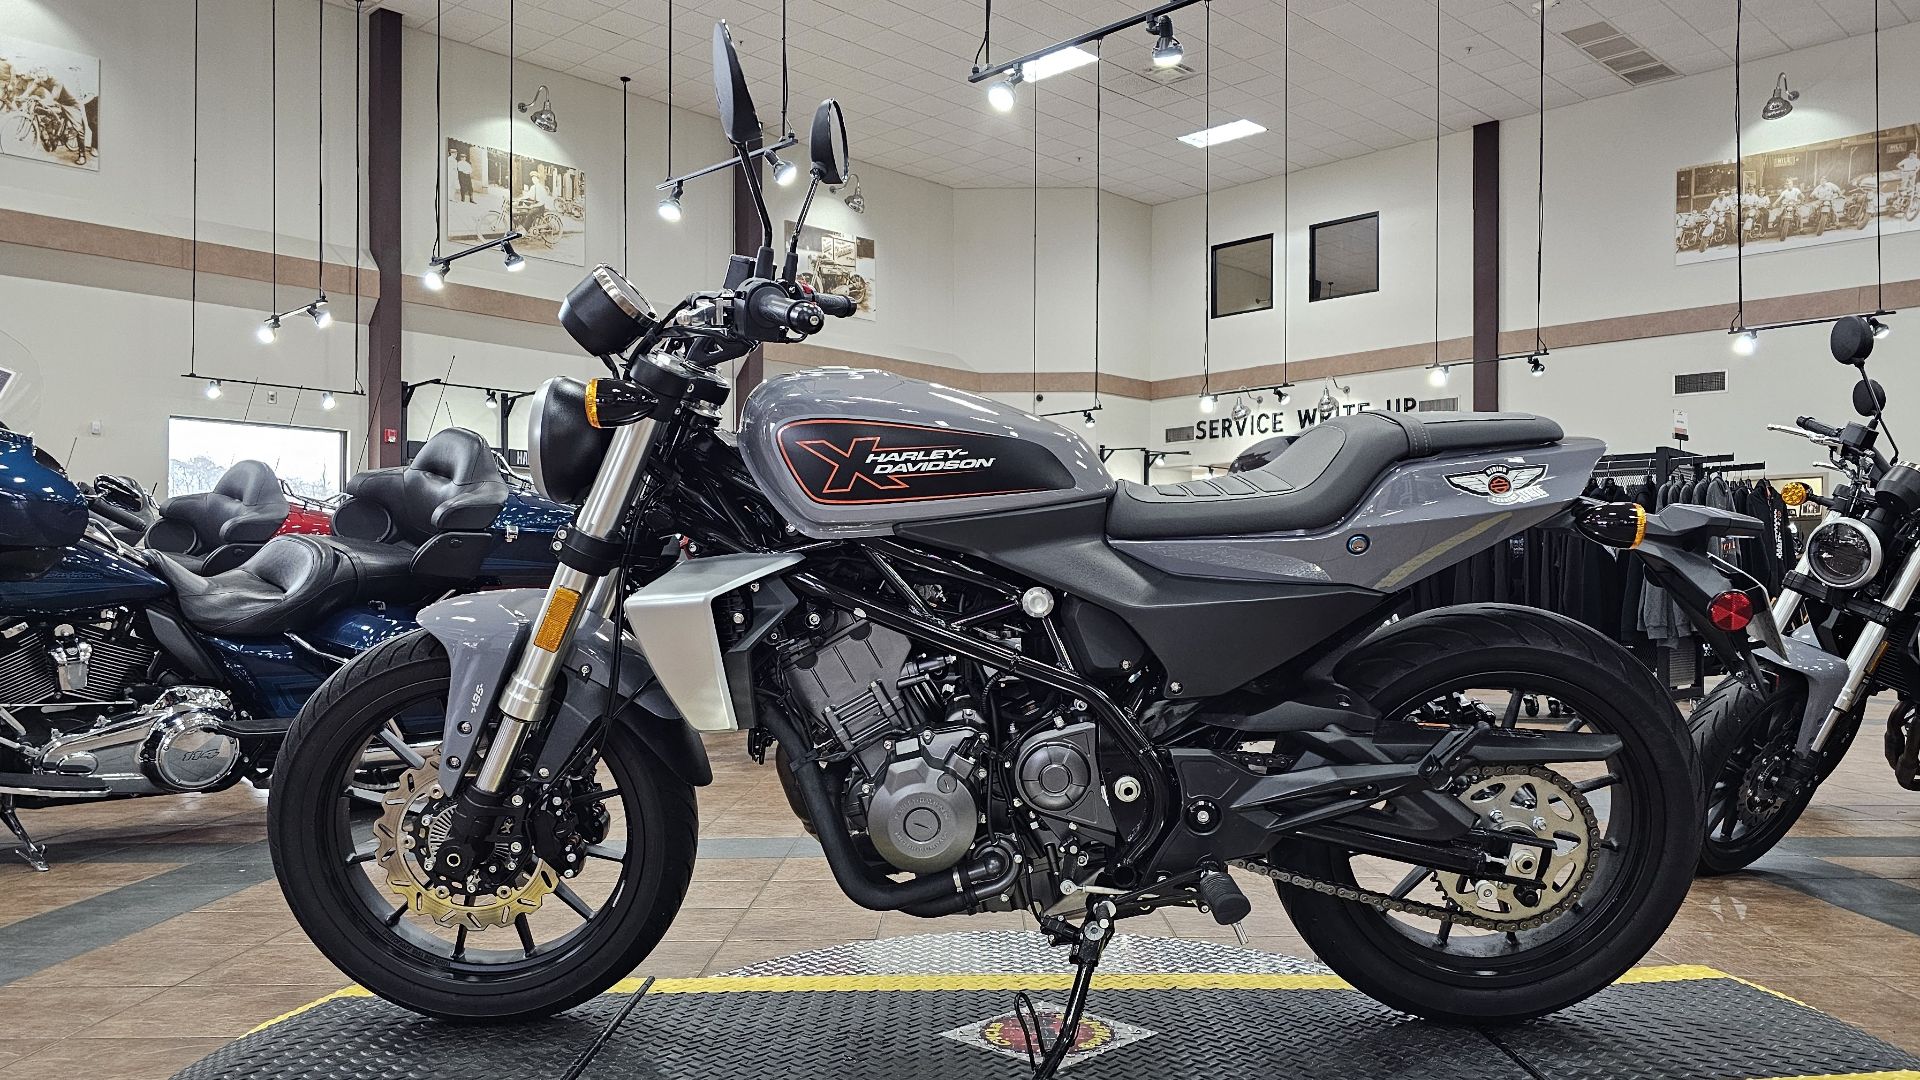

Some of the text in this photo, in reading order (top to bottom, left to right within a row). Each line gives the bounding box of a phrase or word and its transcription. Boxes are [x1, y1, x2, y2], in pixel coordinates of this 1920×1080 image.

[1195, 412, 1284, 440] SERVICE
[865, 448, 969, 464] HARLEY-
[873, 457, 997, 475] DAVIDSON
[182, 748, 220, 761] 114
